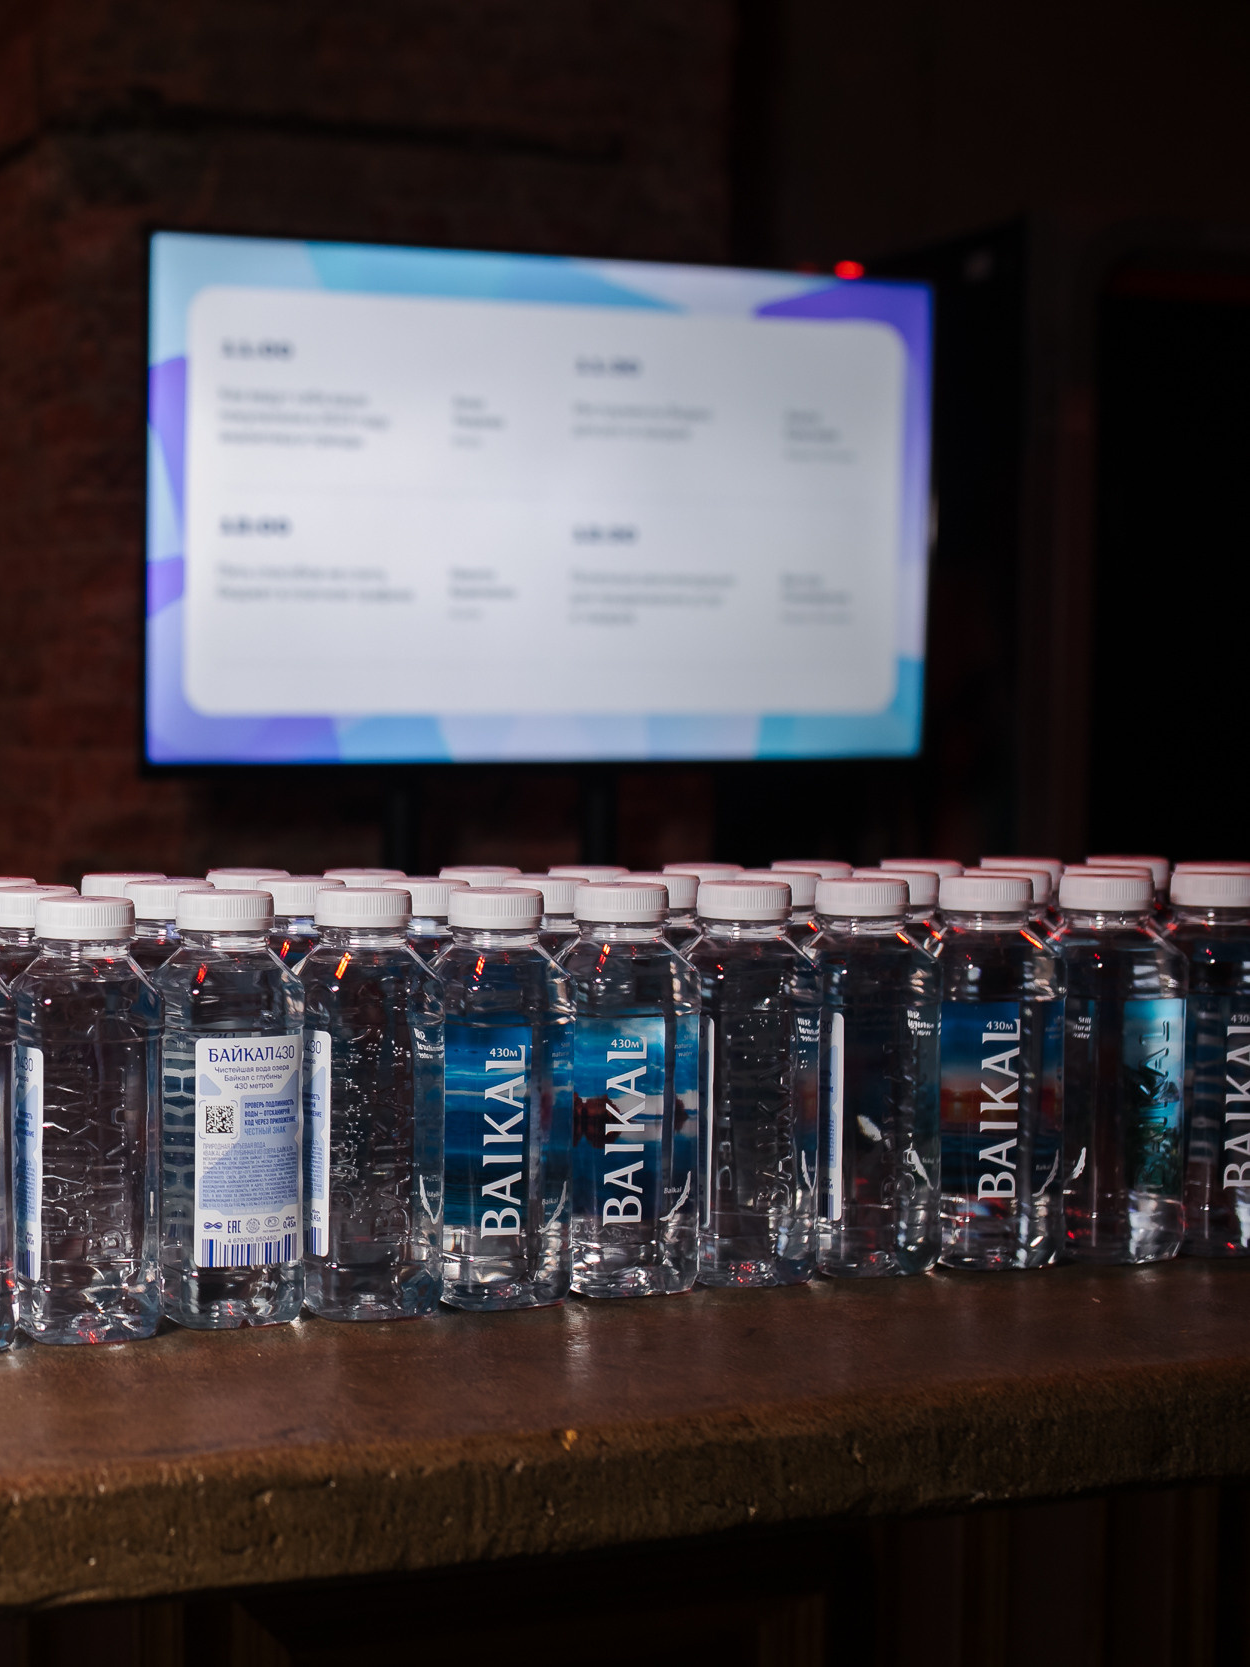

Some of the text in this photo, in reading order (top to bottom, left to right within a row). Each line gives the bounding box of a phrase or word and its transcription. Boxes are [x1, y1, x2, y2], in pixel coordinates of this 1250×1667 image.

[986, 1021, 1013, 1031] 430м
[611, 1039, 640, 1048] 430м
[208, 1045, 273, 1062] БАЙКАЛ
[489, 1048, 518, 1058] 430м
[215, 1064, 290, 1074] Чистейшая вода озера
[224, 1074, 249, 1082] Байкал
[234, 1082, 248, 1090] 430
[244, 1099, 295, 1109] ПРОВЕРЬ ПОДЛИННОСТЬ
[244, 1110, 258, 1118] ВОДЫ
[263, 1108, 290, 1117] ОТСКАНИРУЙ
[978, 1018, 1020, 1201] BAIKAL
[269, 1115, 296, 1125] ПРИЛОЖЕНИЕ
[244, 1126, 287, 1136] ЧЕСТНЫЙ ЗНАК
[603, 1036, 647, 1226] BAIKAL
[481, 1044, 525, 1239] BAIKAL
